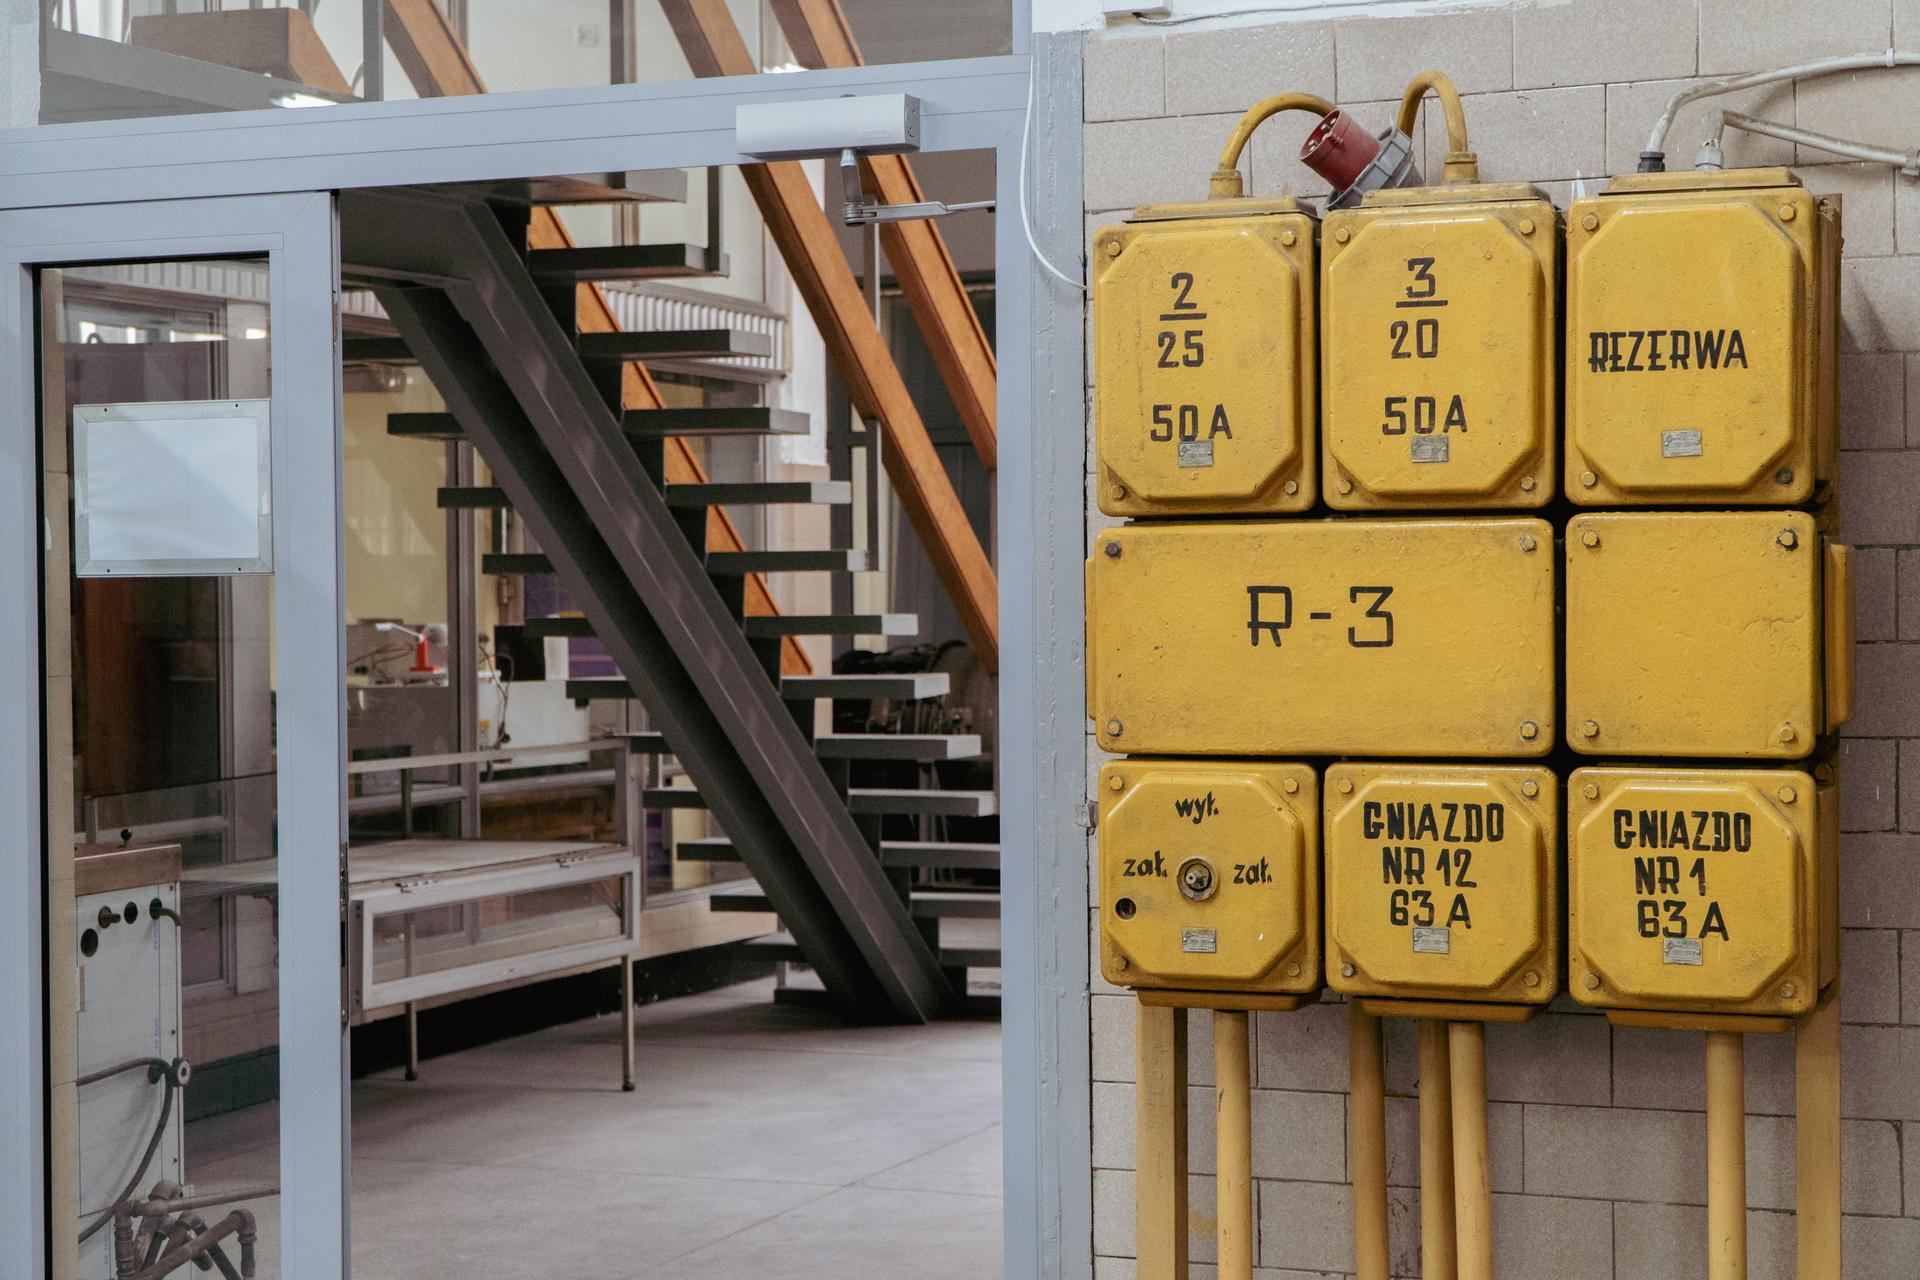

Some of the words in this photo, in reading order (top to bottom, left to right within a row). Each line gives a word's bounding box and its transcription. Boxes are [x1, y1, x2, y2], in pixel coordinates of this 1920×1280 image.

[1171, 272, 1198, 310] 2
[1406, 257, 1436, 299] 3
[1157, 330, 1204, 369] 25
[1390, 318, 1439, 360] 20
[1587, 329, 1749, 374] REZERWA
[1363, 800, 1505, 844] GNIAZDO
[1613, 808, 1752, 853] GNIAZDO
[1382, 846, 1426, 886] NR
[1435, 848, 1478, 889] 12
[1633, 855, 1680, 896] NR
[1689, 857, 1707, 897] 1
[1389, 888, 1435, 930] 63
[1445, 892, 1472, 930] A
[1637, 899, 1688, 939] 63
[1698, 900, 1730, 942] A
